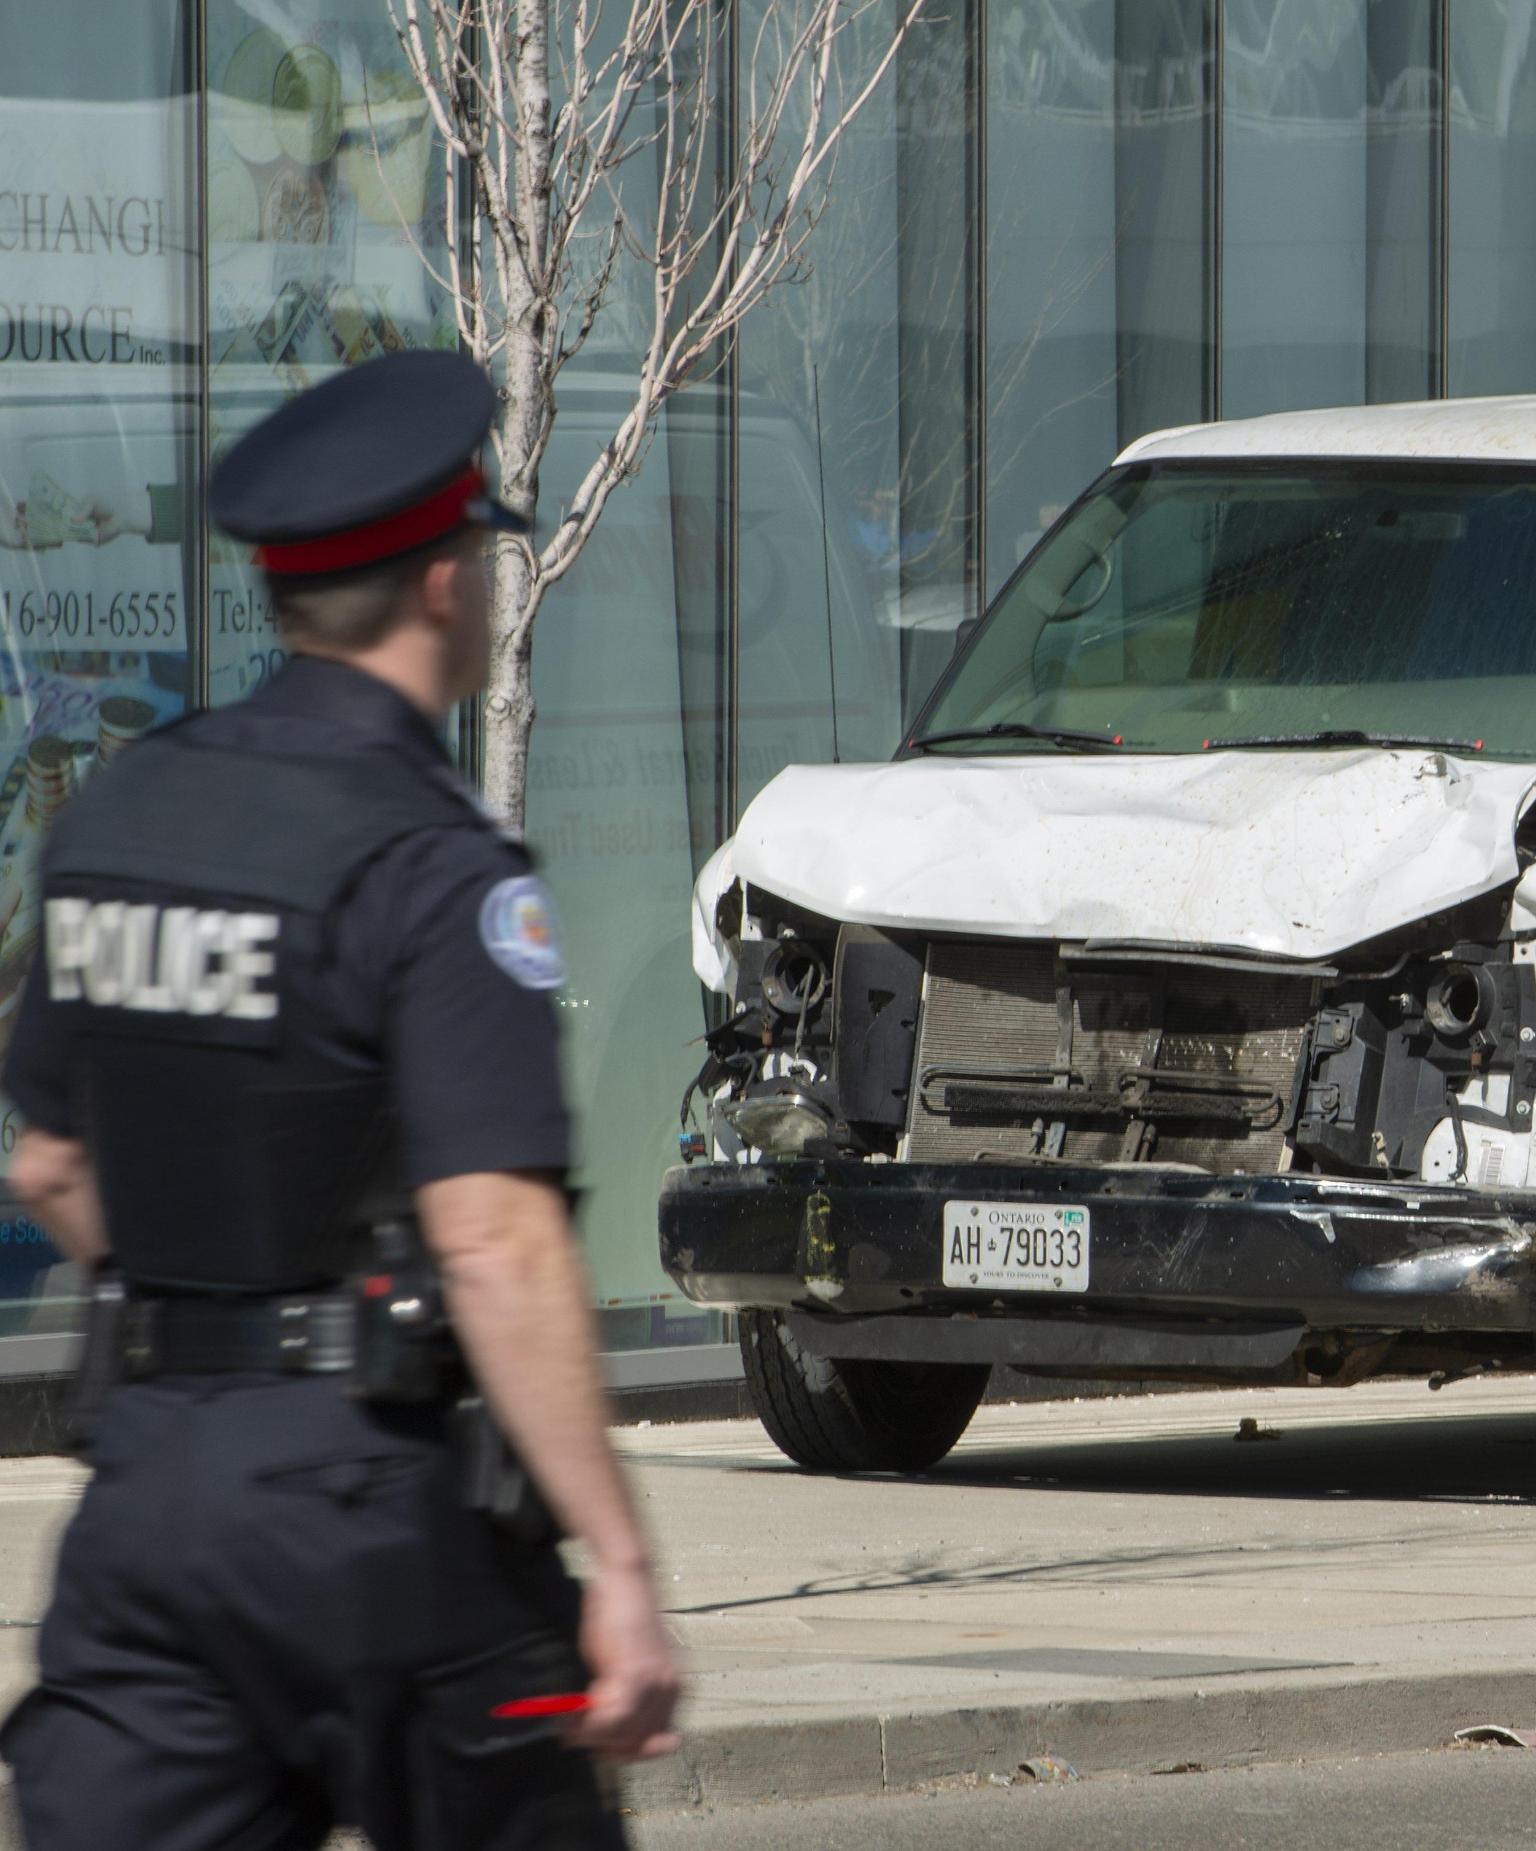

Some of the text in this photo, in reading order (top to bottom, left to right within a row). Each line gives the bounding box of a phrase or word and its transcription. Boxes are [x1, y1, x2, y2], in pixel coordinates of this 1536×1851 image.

[140, 344, 166, 365] Inc.
[46, 897, 280, 1020] POLICE
[988, 1210, 1045, 1225] ONTARIO
[950, 1225, 1081, 1269] AH 79033
